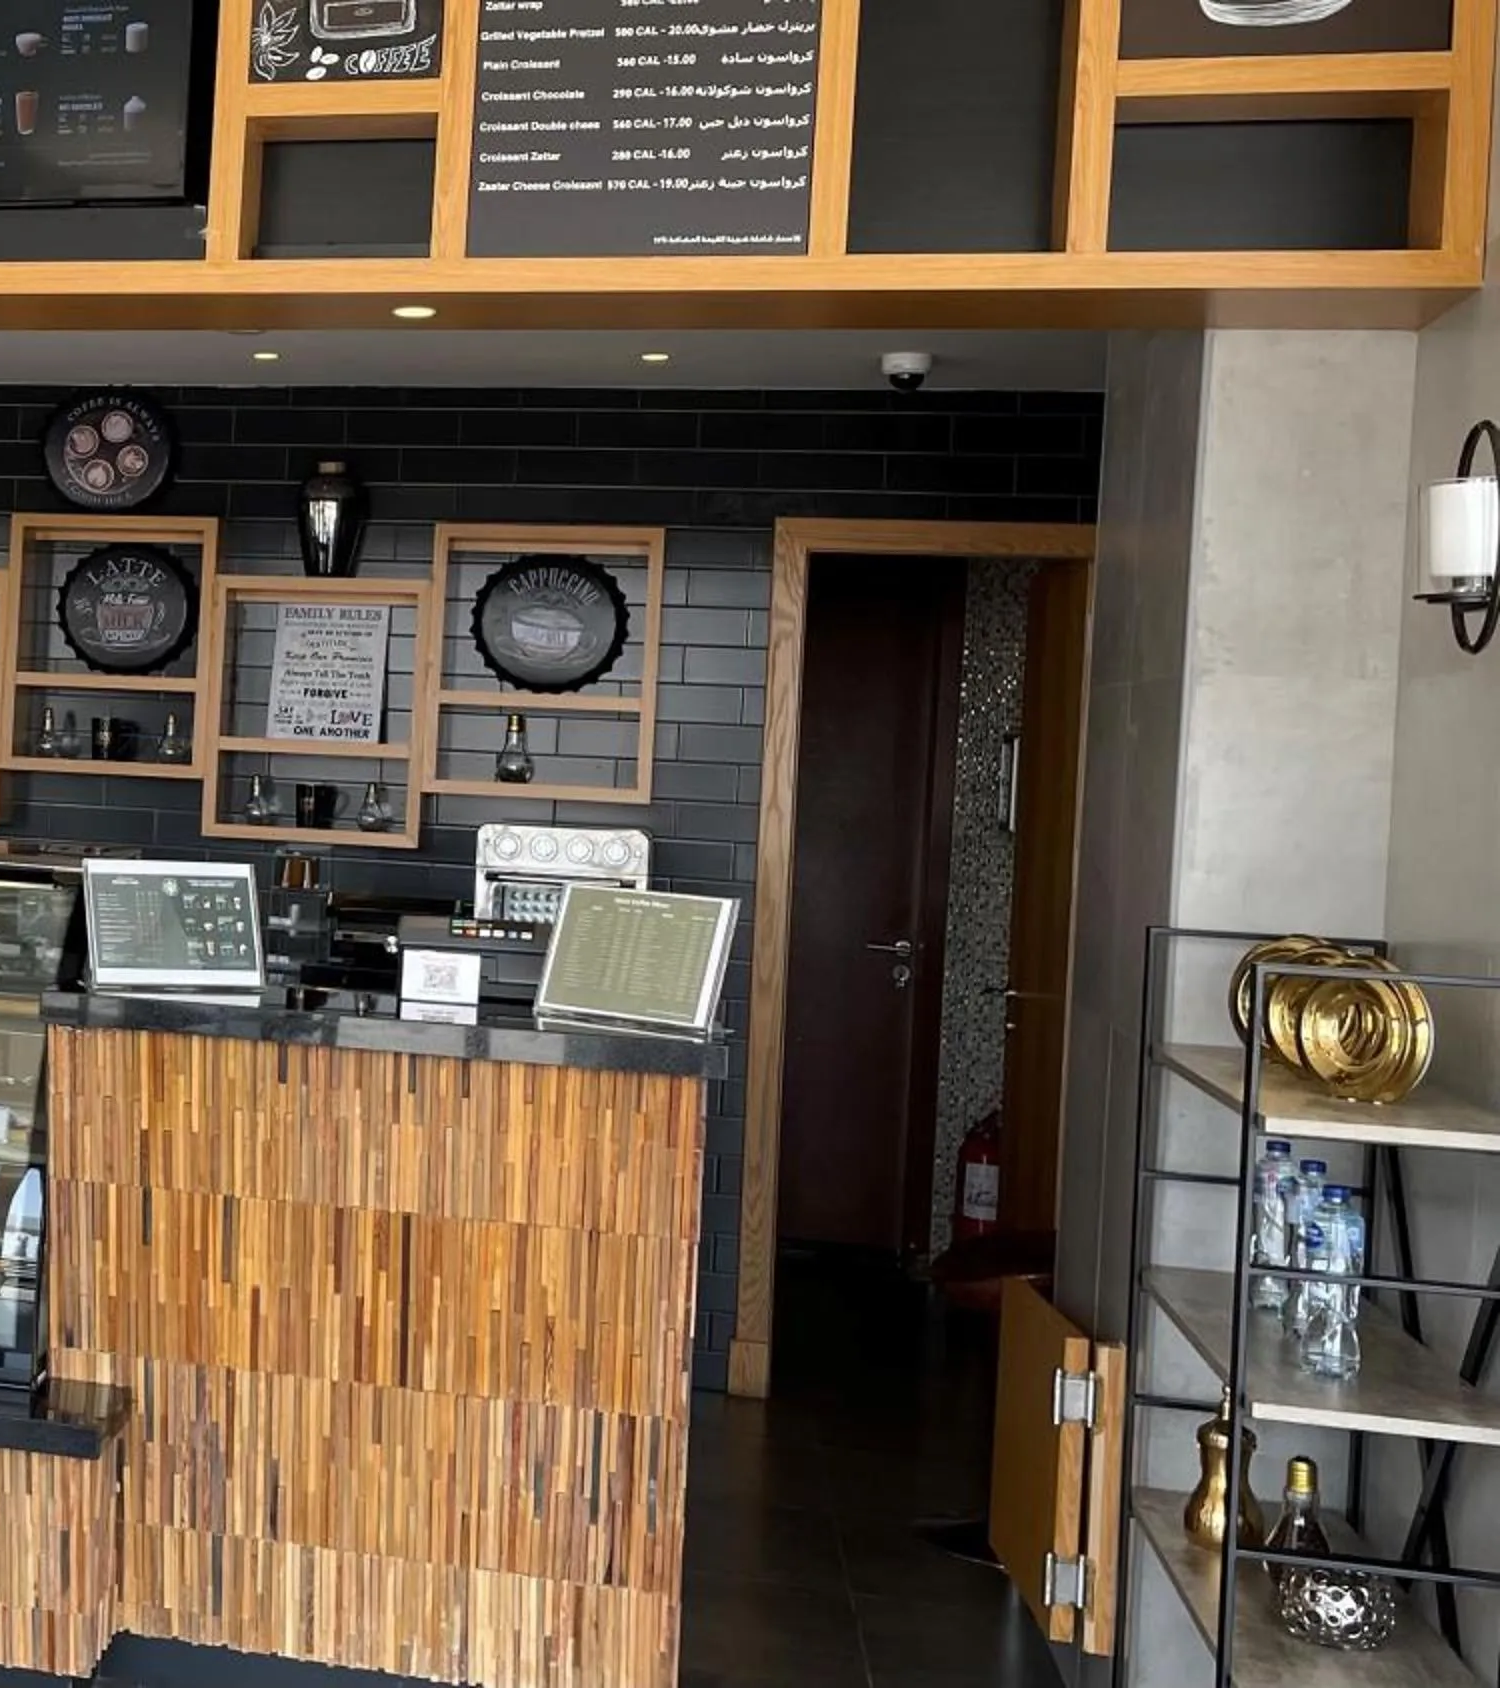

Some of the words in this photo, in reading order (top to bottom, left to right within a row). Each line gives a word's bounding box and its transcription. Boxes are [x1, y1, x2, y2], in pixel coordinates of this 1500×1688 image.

[517, 30, 566, 41] Vegetable
[636, 26, 658, 36] CAL
[484, 62, 508, 70] Plain
[511, 60, 560, 69] Croissant
[638, 56, 660, 65] CAL
[482, 92, 530, 101] Croissant
[533, 90, 584, 100] Chocolate
[634, 88, 656, 97] CAL
[480, 122, 528, 131] Croissant
[531, 122, 567, 130] Double
[480, 153, 528, 162] Croissant
[634, 150, 656, 159] CAL
[512, 182, 550, 190] Cheese
[553, 181, 602, 190] Croissant
[628, 180, 650, 189] CAL
[87, 557, 167, 587] LATTE
[507, 568, 599, 606] CAPPUCCINO
[285, 607, 336, 619] FAMILY
[339, 609, 382, 621] RULES
[303, 687, 348, 699] FORGIVE
[330, 708, 373, 727] LOVE
[293, 726, 314, 737] ONE
[319, 727, 370, 740] ANOTHER
